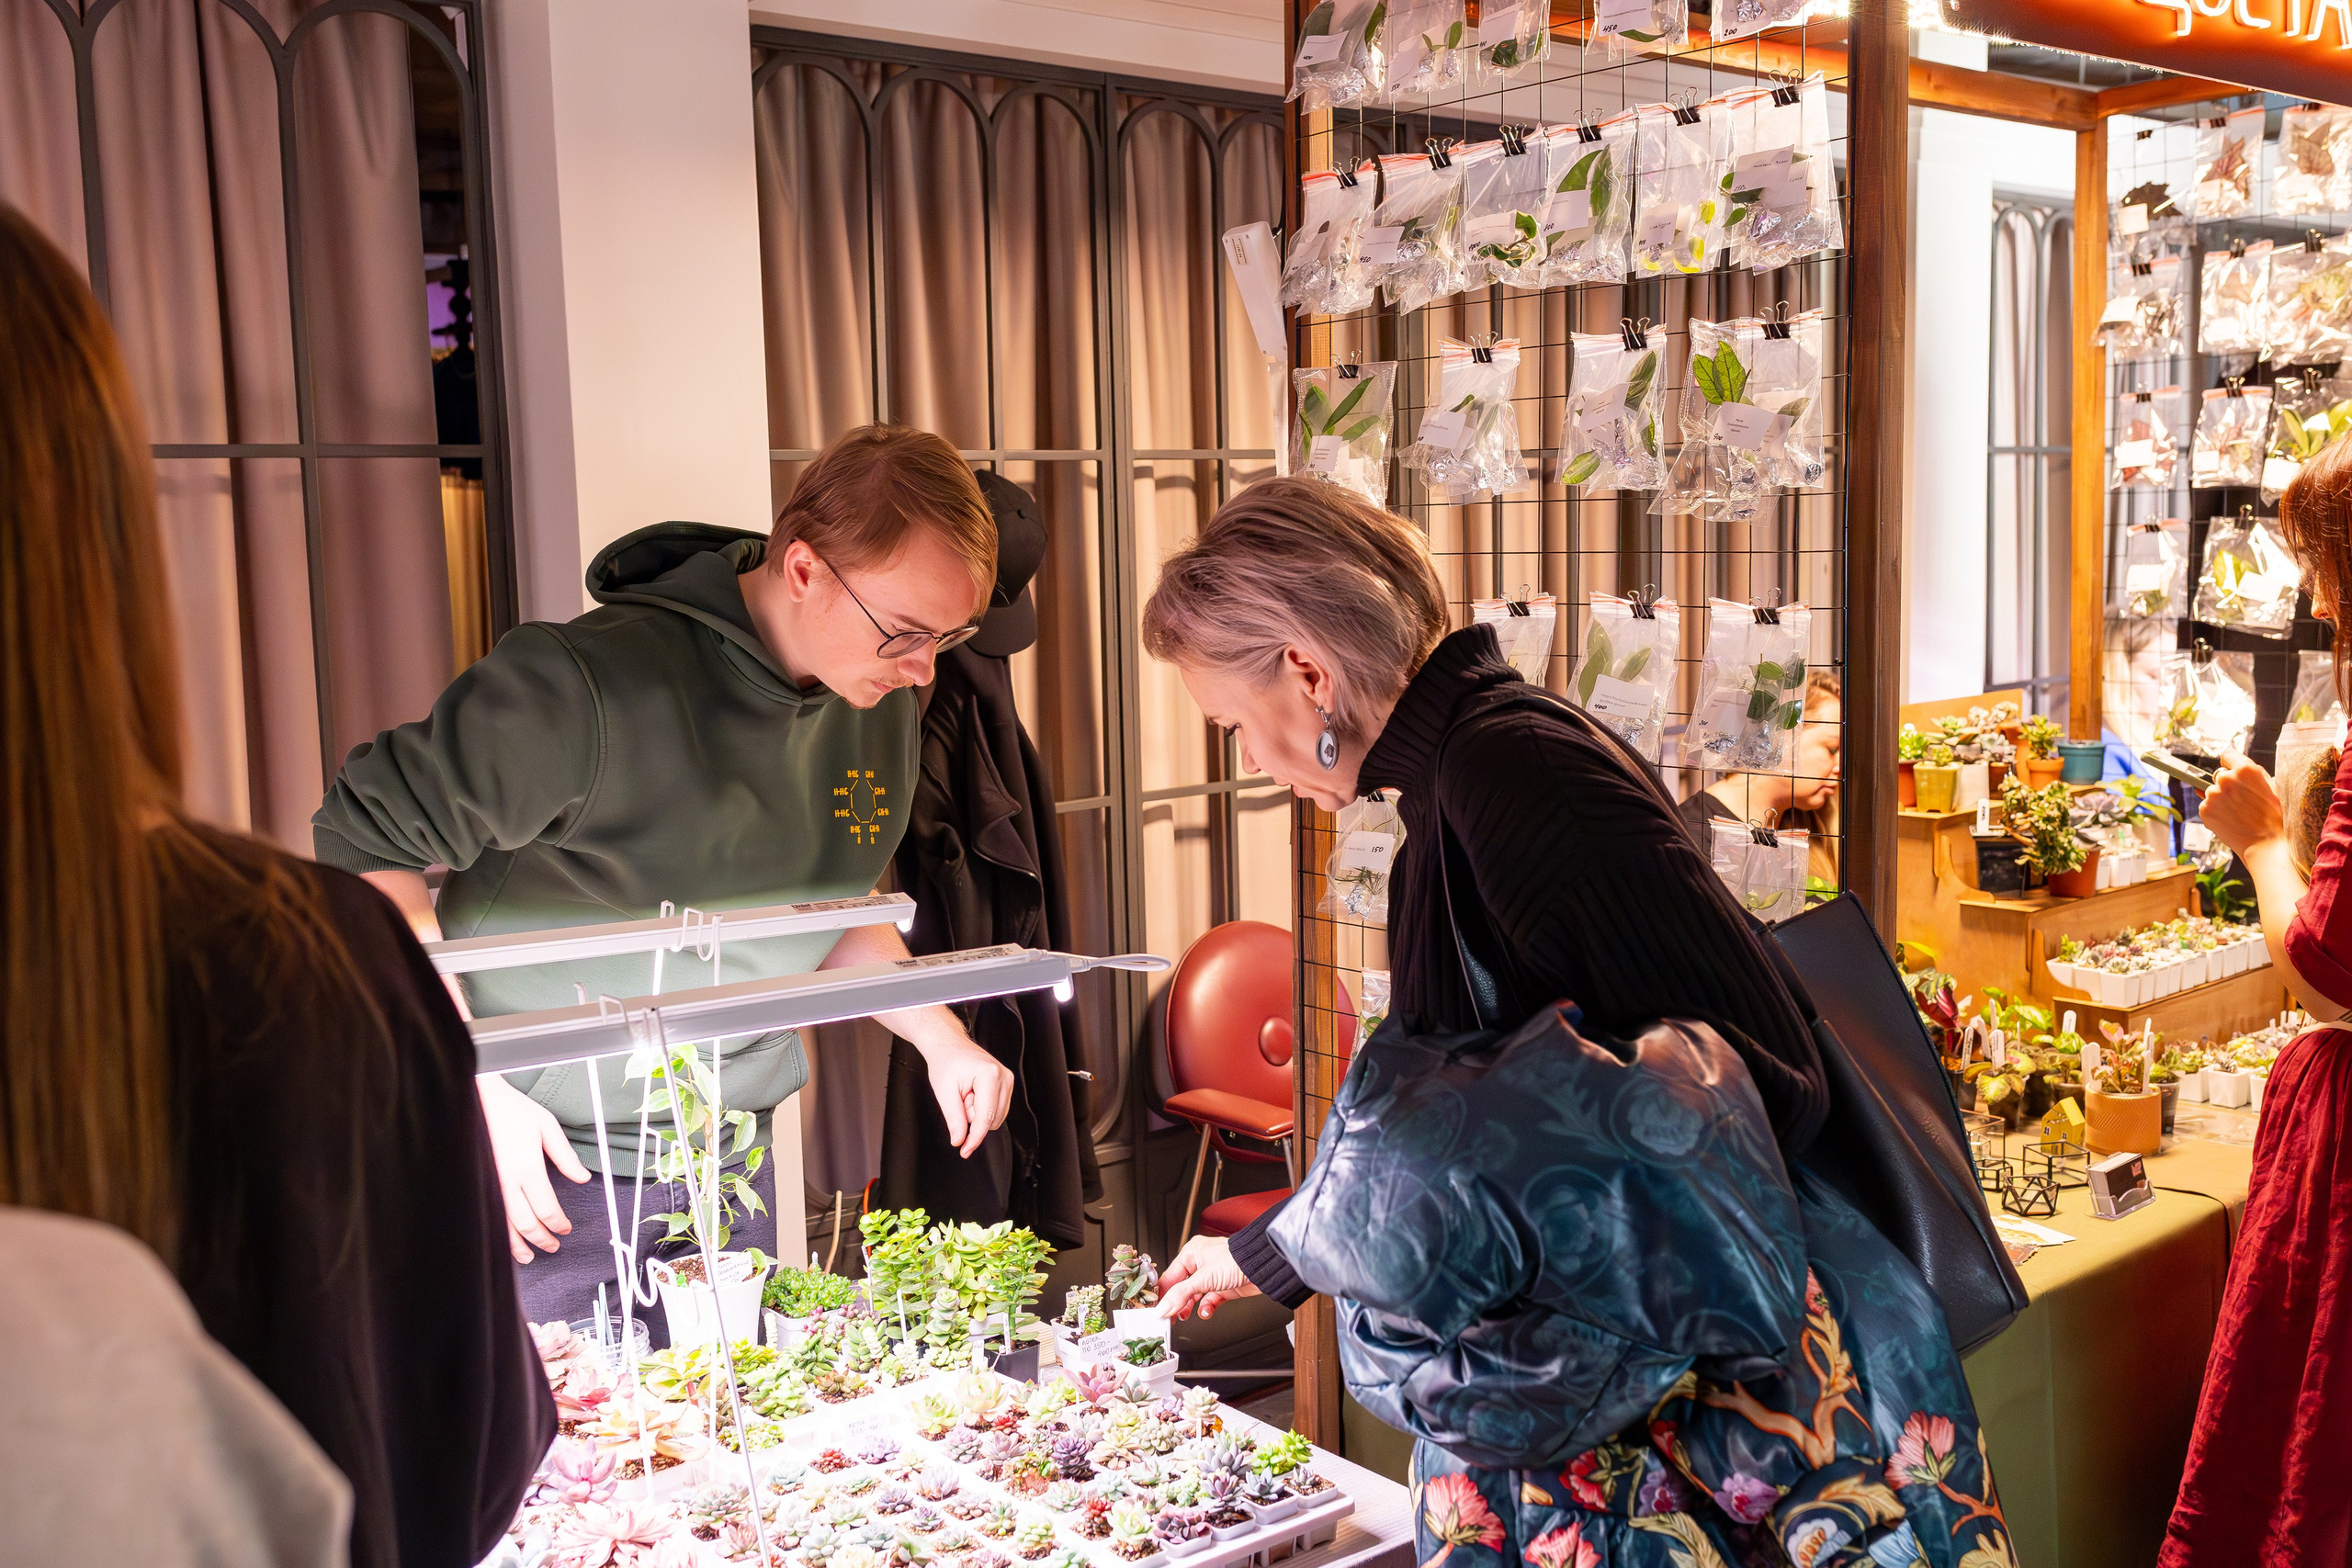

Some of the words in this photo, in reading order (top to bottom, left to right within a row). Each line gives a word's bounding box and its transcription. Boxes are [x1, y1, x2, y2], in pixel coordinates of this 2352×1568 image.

[1602, 24, 1618, 33] 450
[1371, 845, 1385, 853] 150
[1081, 1335, 1101, 1347] ЛОТОК
[1081, 1346, 1091, 1354] ПО
